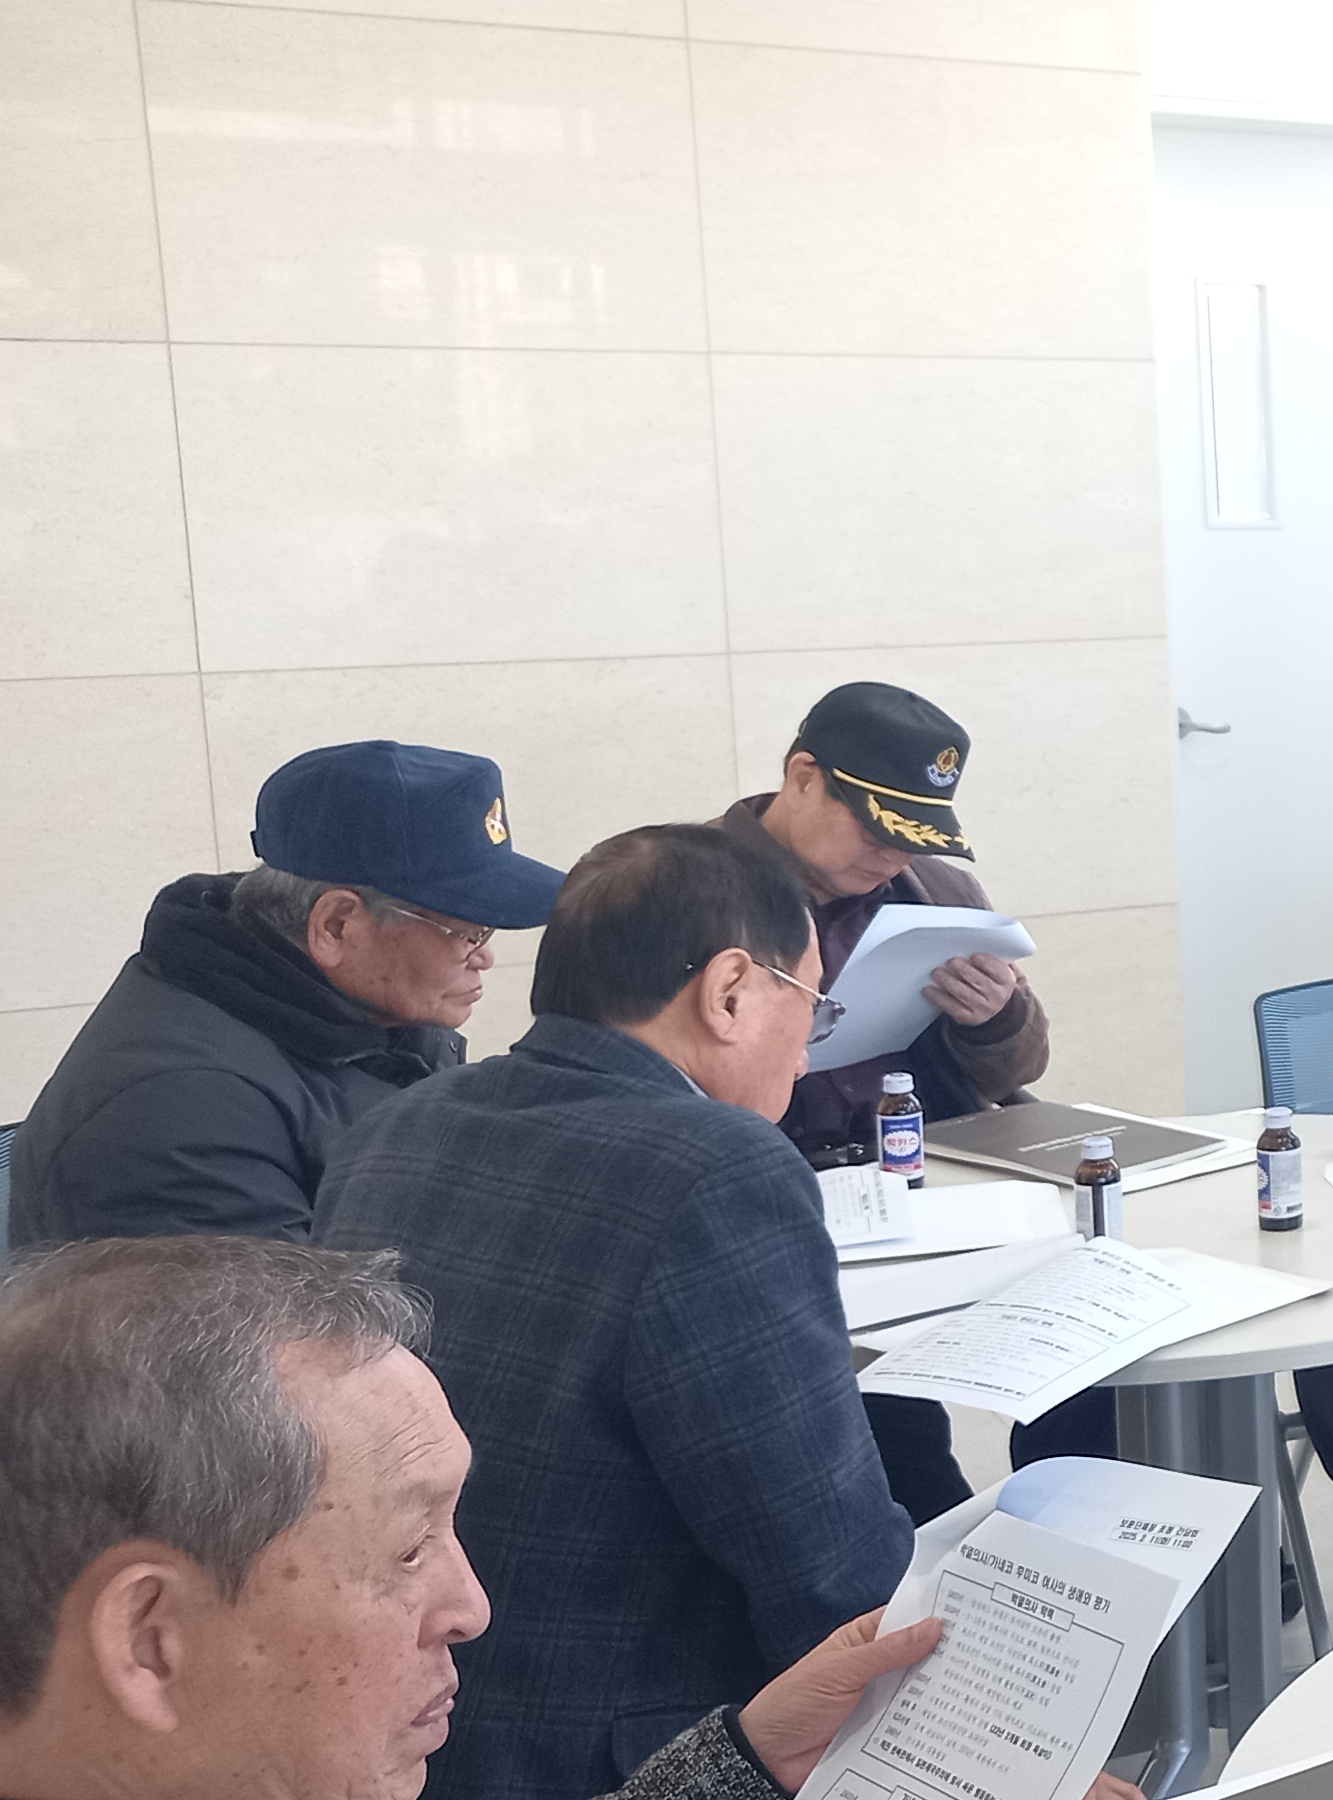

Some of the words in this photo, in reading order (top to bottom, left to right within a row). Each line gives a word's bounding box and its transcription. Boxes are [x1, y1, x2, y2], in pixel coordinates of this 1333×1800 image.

[1016, 1564, 1041, 1585] 후미코
[1042, 1574, 1067, 1596] 여사의
[1067, 1585, 1093, 1606] 생애와
[1093, 1595, 1112, 1614] 평가
